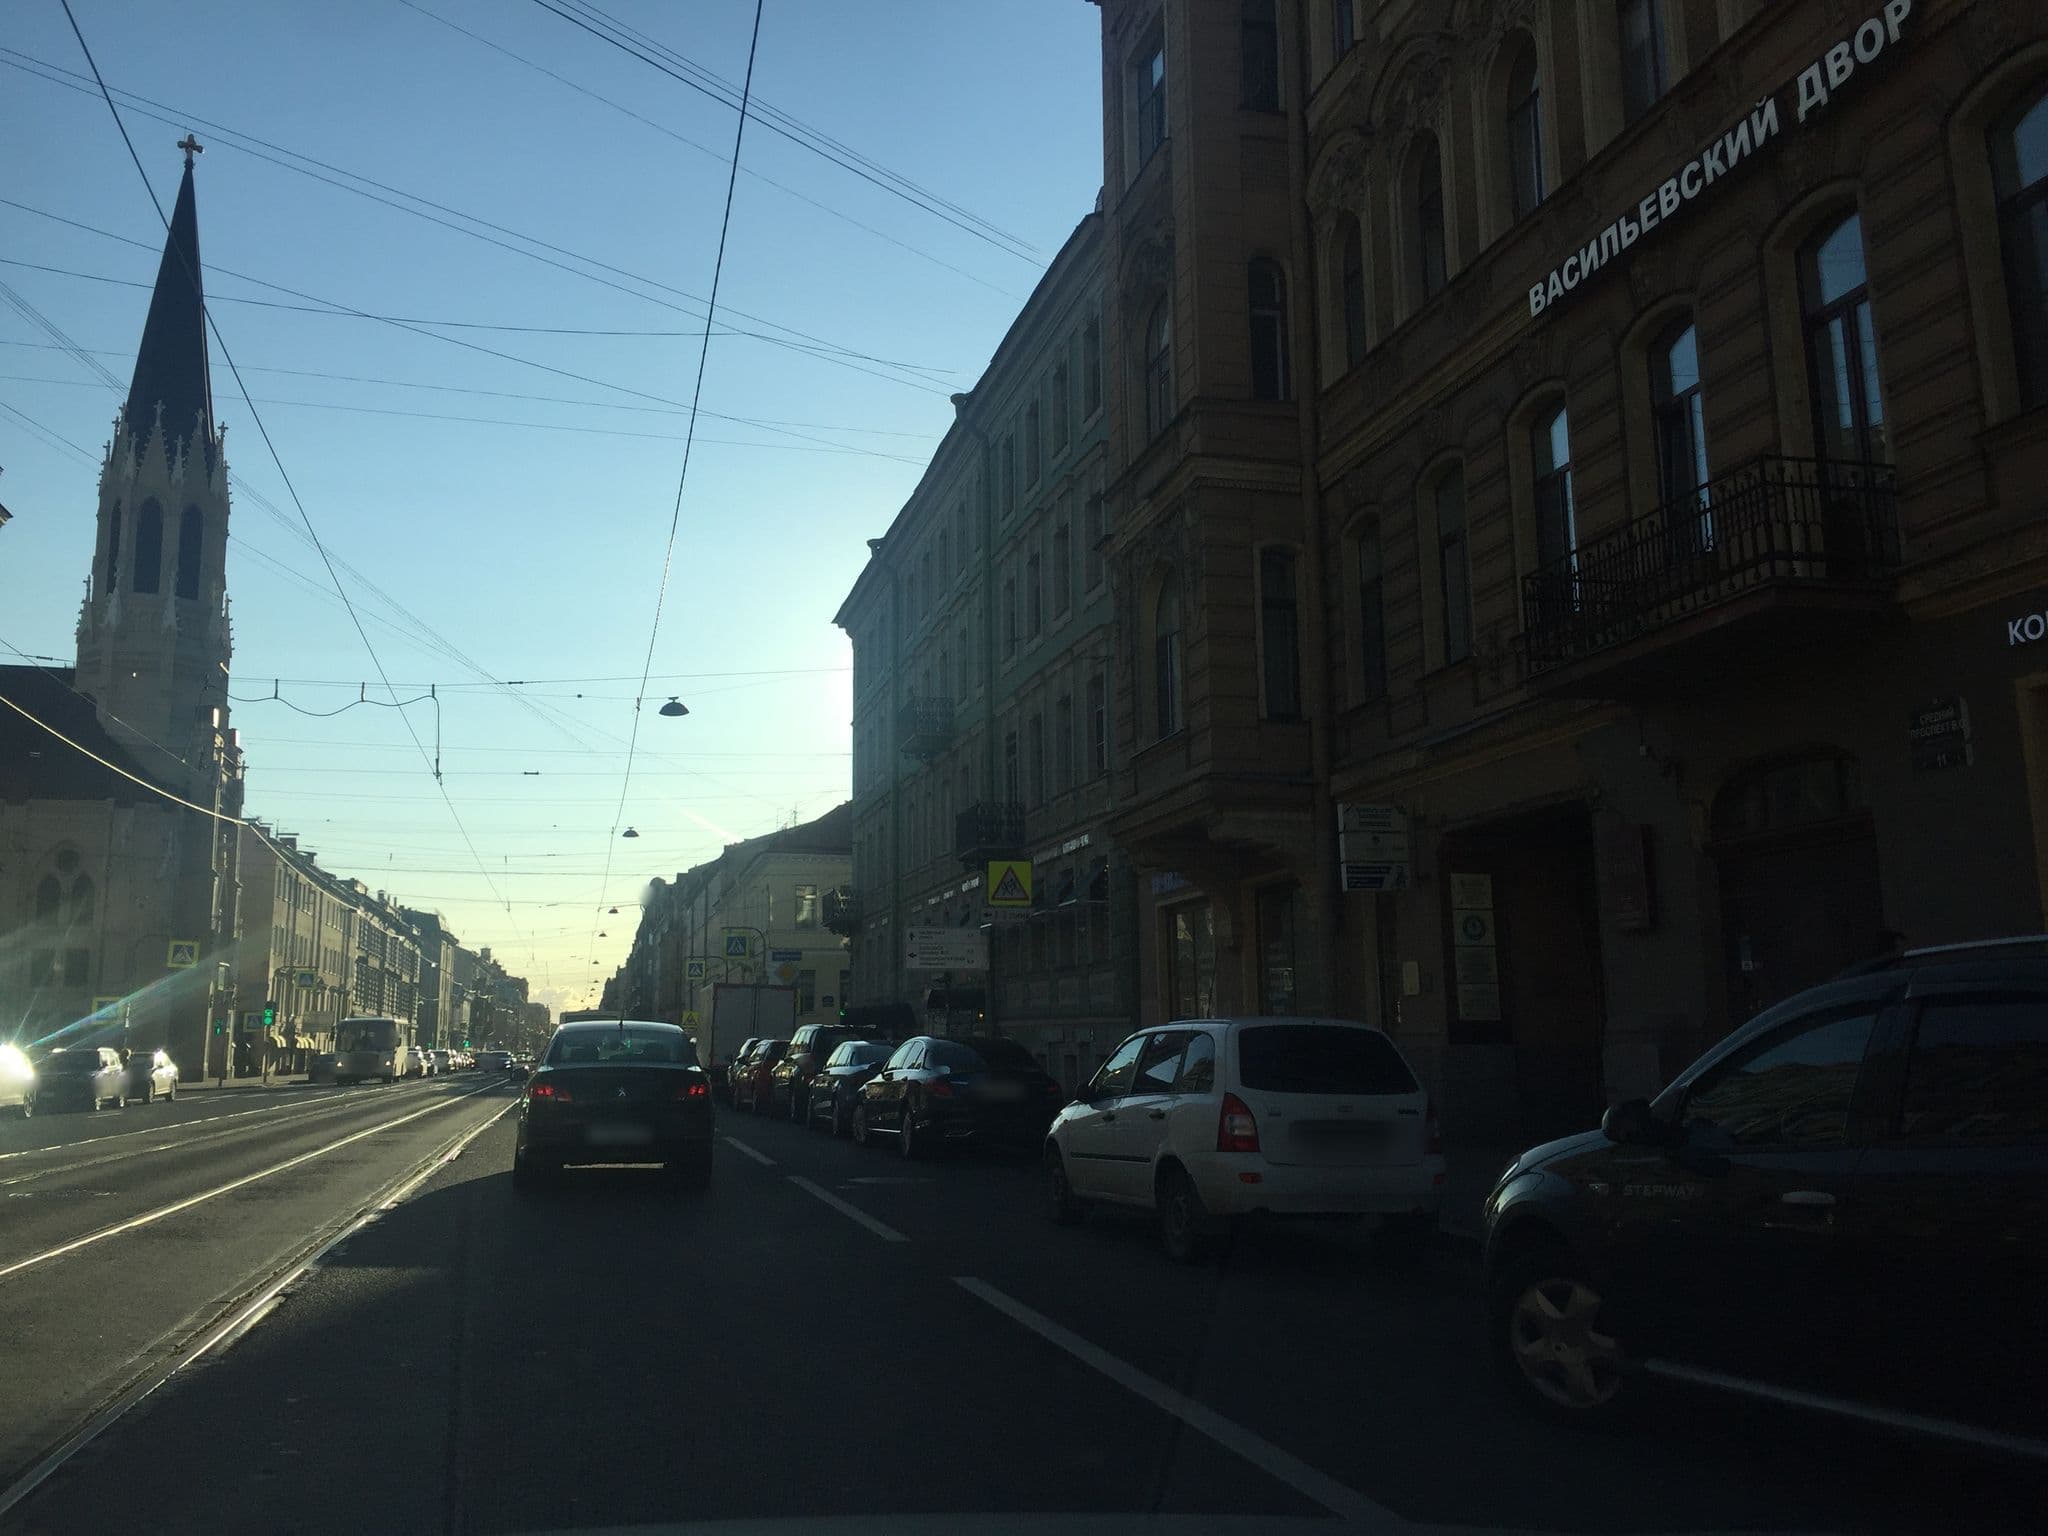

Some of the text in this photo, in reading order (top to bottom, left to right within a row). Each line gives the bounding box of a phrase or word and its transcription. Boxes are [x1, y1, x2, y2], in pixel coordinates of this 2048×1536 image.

[1528, 0, 1913, 318] ВАСИЛЬЕВСКИЙ ДВОР
[2007, 610, 2048, 646] КО
